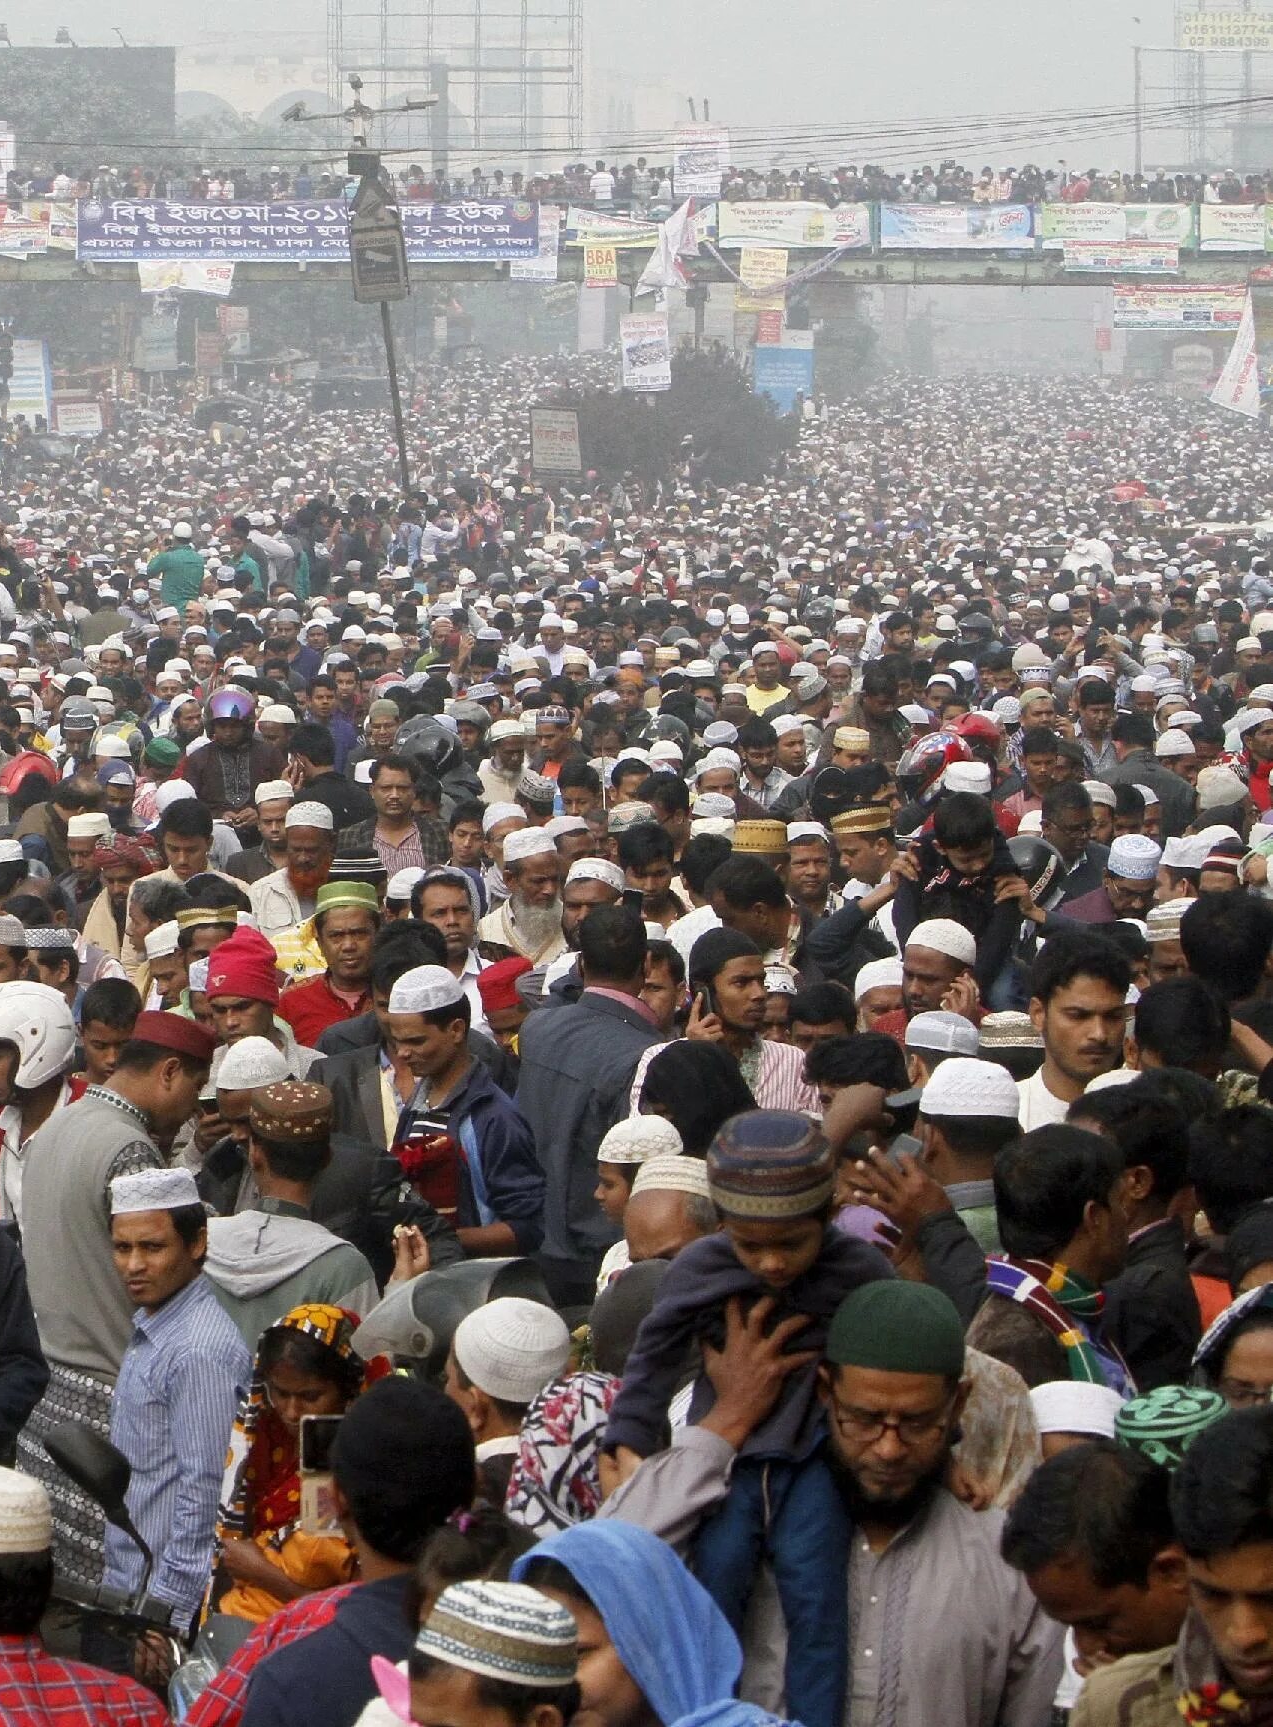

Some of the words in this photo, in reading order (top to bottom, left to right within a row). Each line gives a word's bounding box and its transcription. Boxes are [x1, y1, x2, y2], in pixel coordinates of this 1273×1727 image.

[110, 202, 158, 221] বিশ্ব
[445, 201, 506, 220] হউক
[102, 223, 139, 236] বিশ্ব
[147, 222, 241, 236] ইজতেমায়
[249, 224, 308, 236] আগত
[157, 238, 202, 248] উত্তরা
[274, 239, 313, 248] ঢাকা
[494, 238, 533, 247] ঢাকা
[586, 249, 615, 265] BBA
